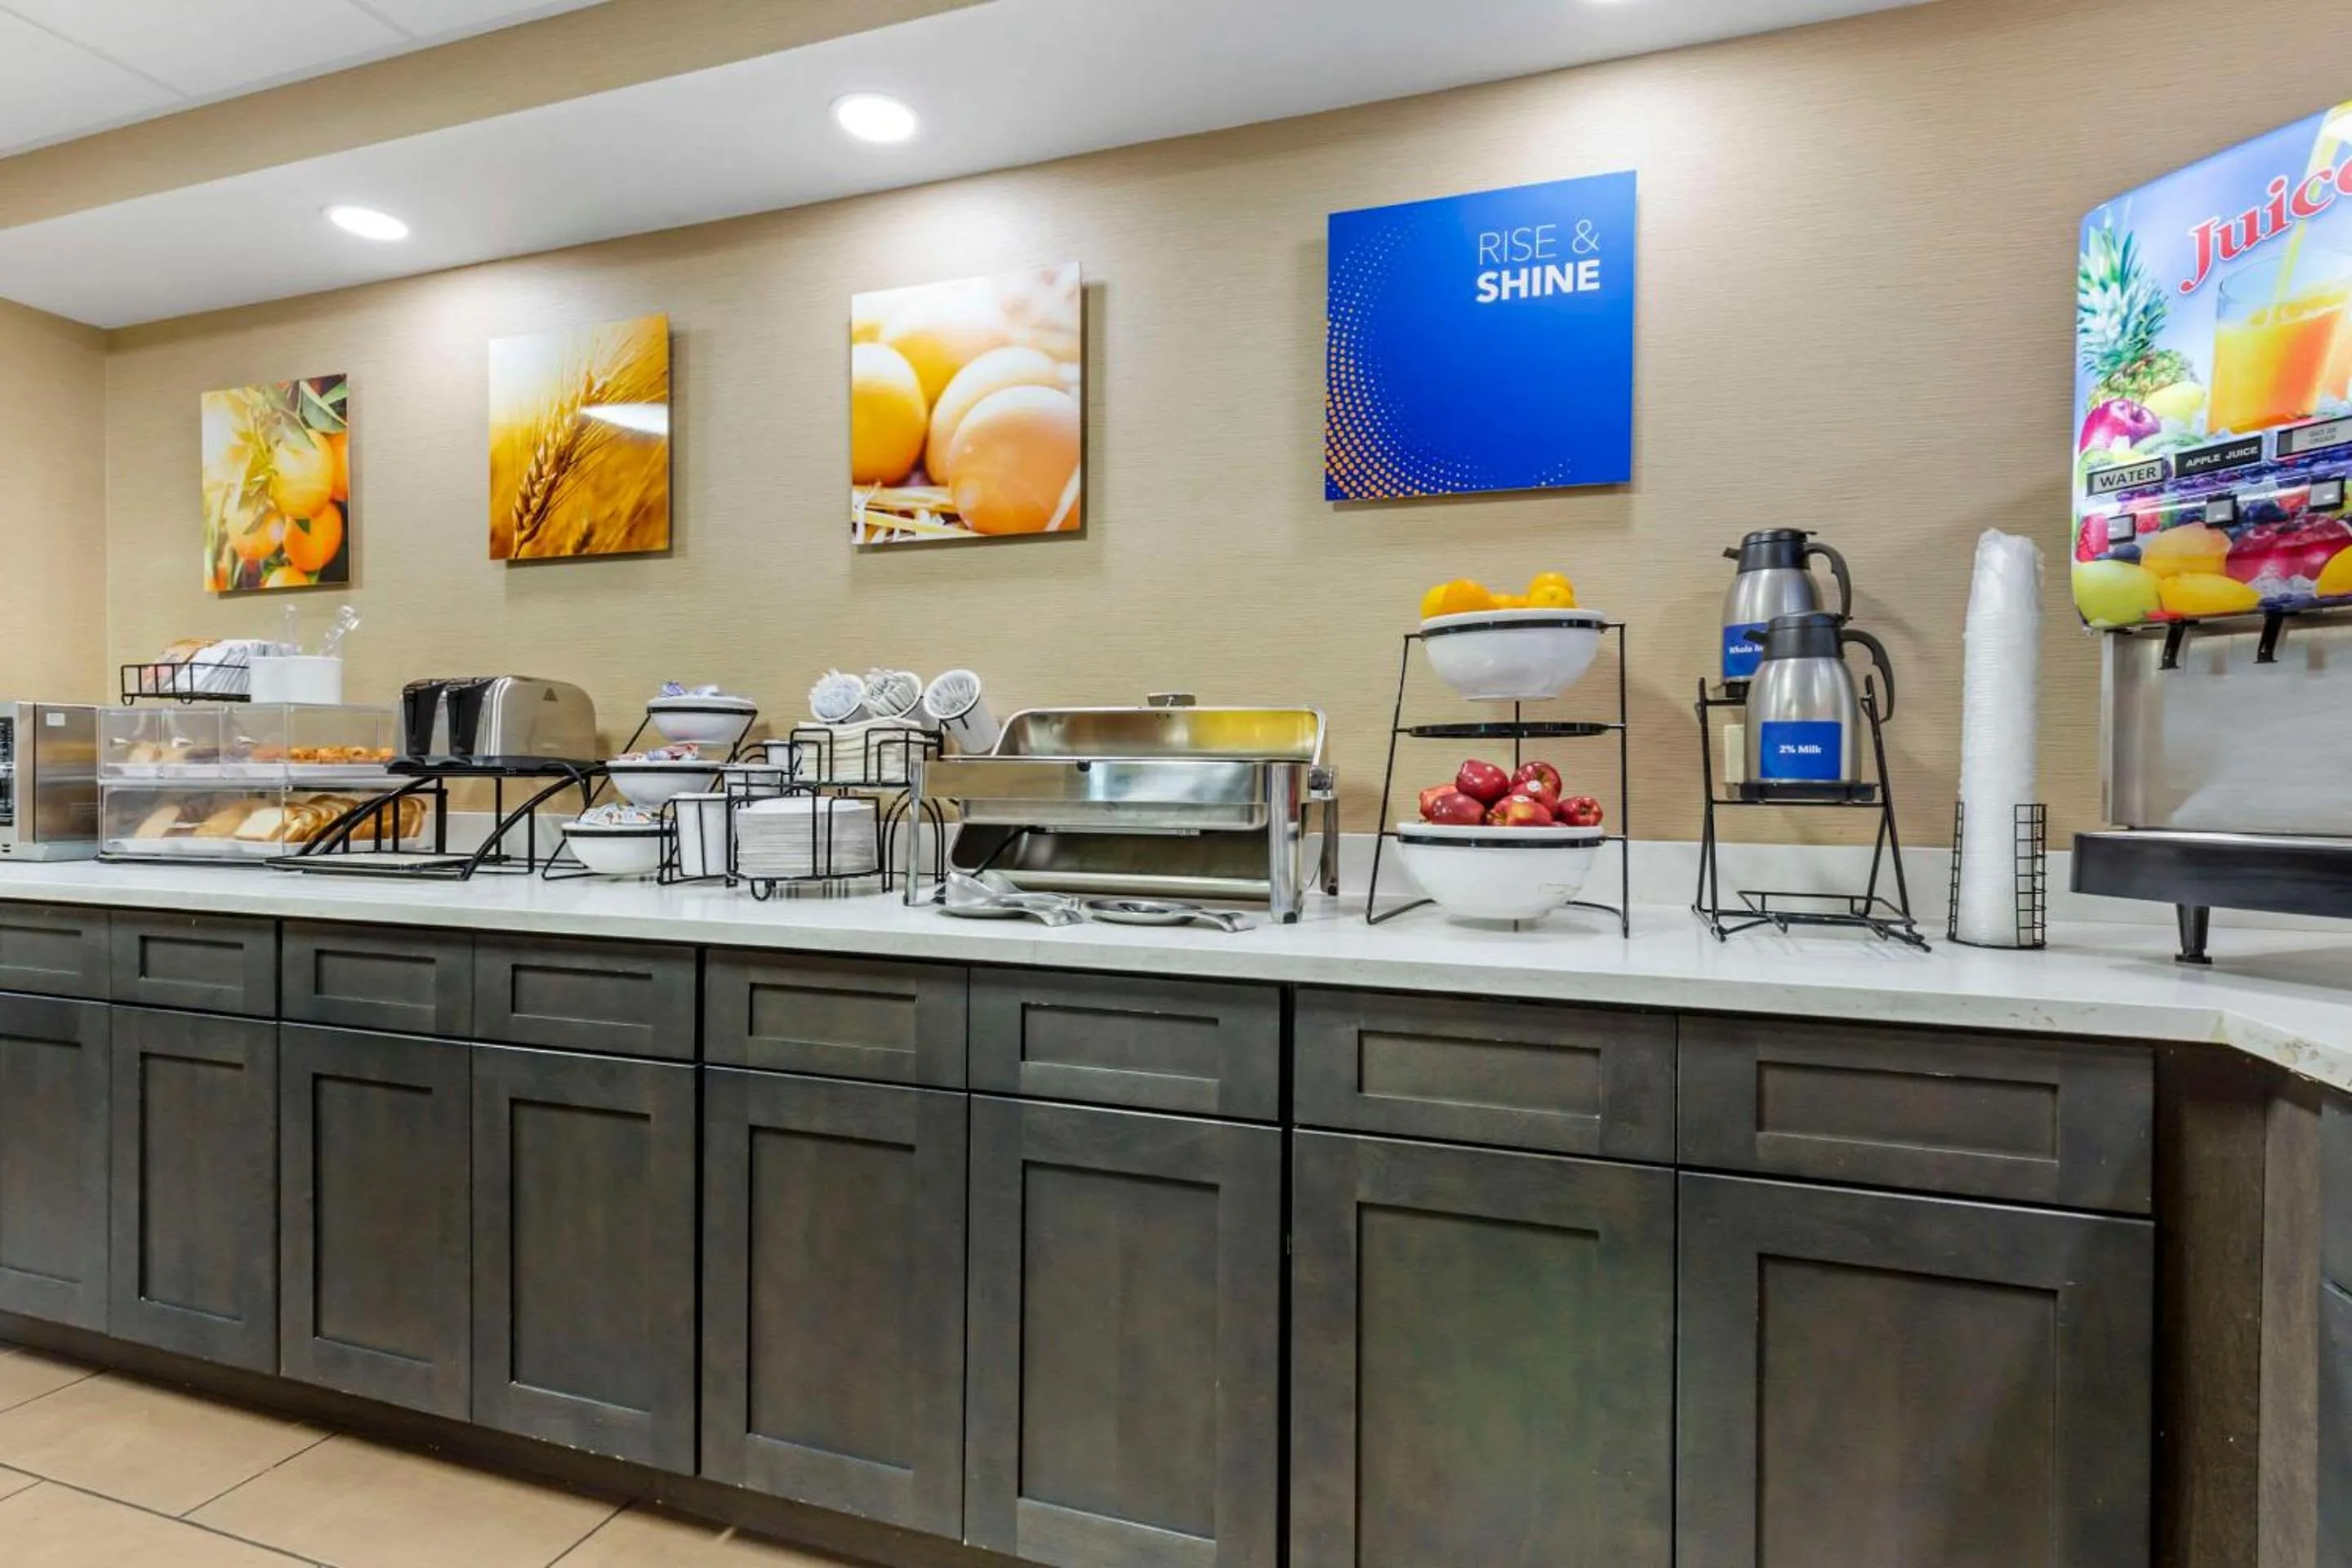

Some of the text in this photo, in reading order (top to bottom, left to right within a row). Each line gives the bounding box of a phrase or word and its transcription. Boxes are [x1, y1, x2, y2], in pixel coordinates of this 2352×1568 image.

[1479, 219, 1601, 265] RISE &
[1476, 259, 1601, 304] SHINE
[2185, 446, 2259, 468] APPLE JUICE
[2100, 466, 2158, 488] WATER
[1780, 744, 1822, 754] 2% Milk
